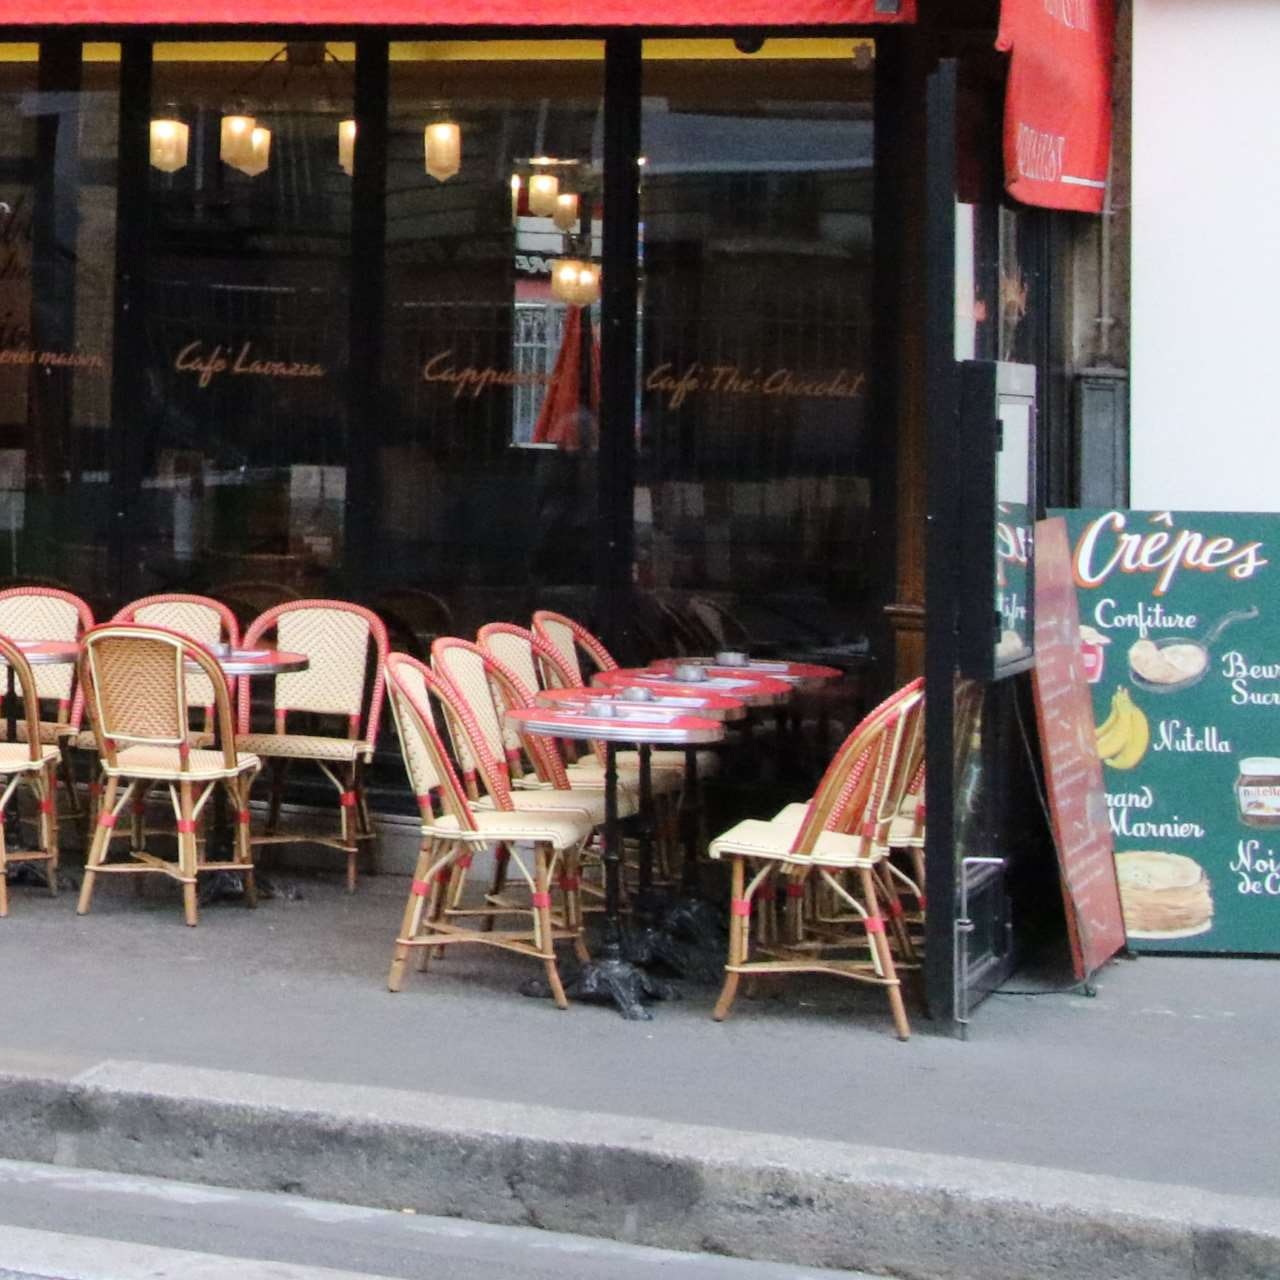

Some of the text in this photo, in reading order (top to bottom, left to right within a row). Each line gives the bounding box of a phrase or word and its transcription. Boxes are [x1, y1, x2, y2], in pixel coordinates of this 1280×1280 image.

[1075, 510, 1269, 596] Crêpes
[1095, 597, 1198, 638] Confiture
[1153, 719, 1232, 753] Nutella
[1104, 785, 1154, 810] rand
[1230, 839, 1280, 873] Noi
[1238, 872, 1263, 894] de
